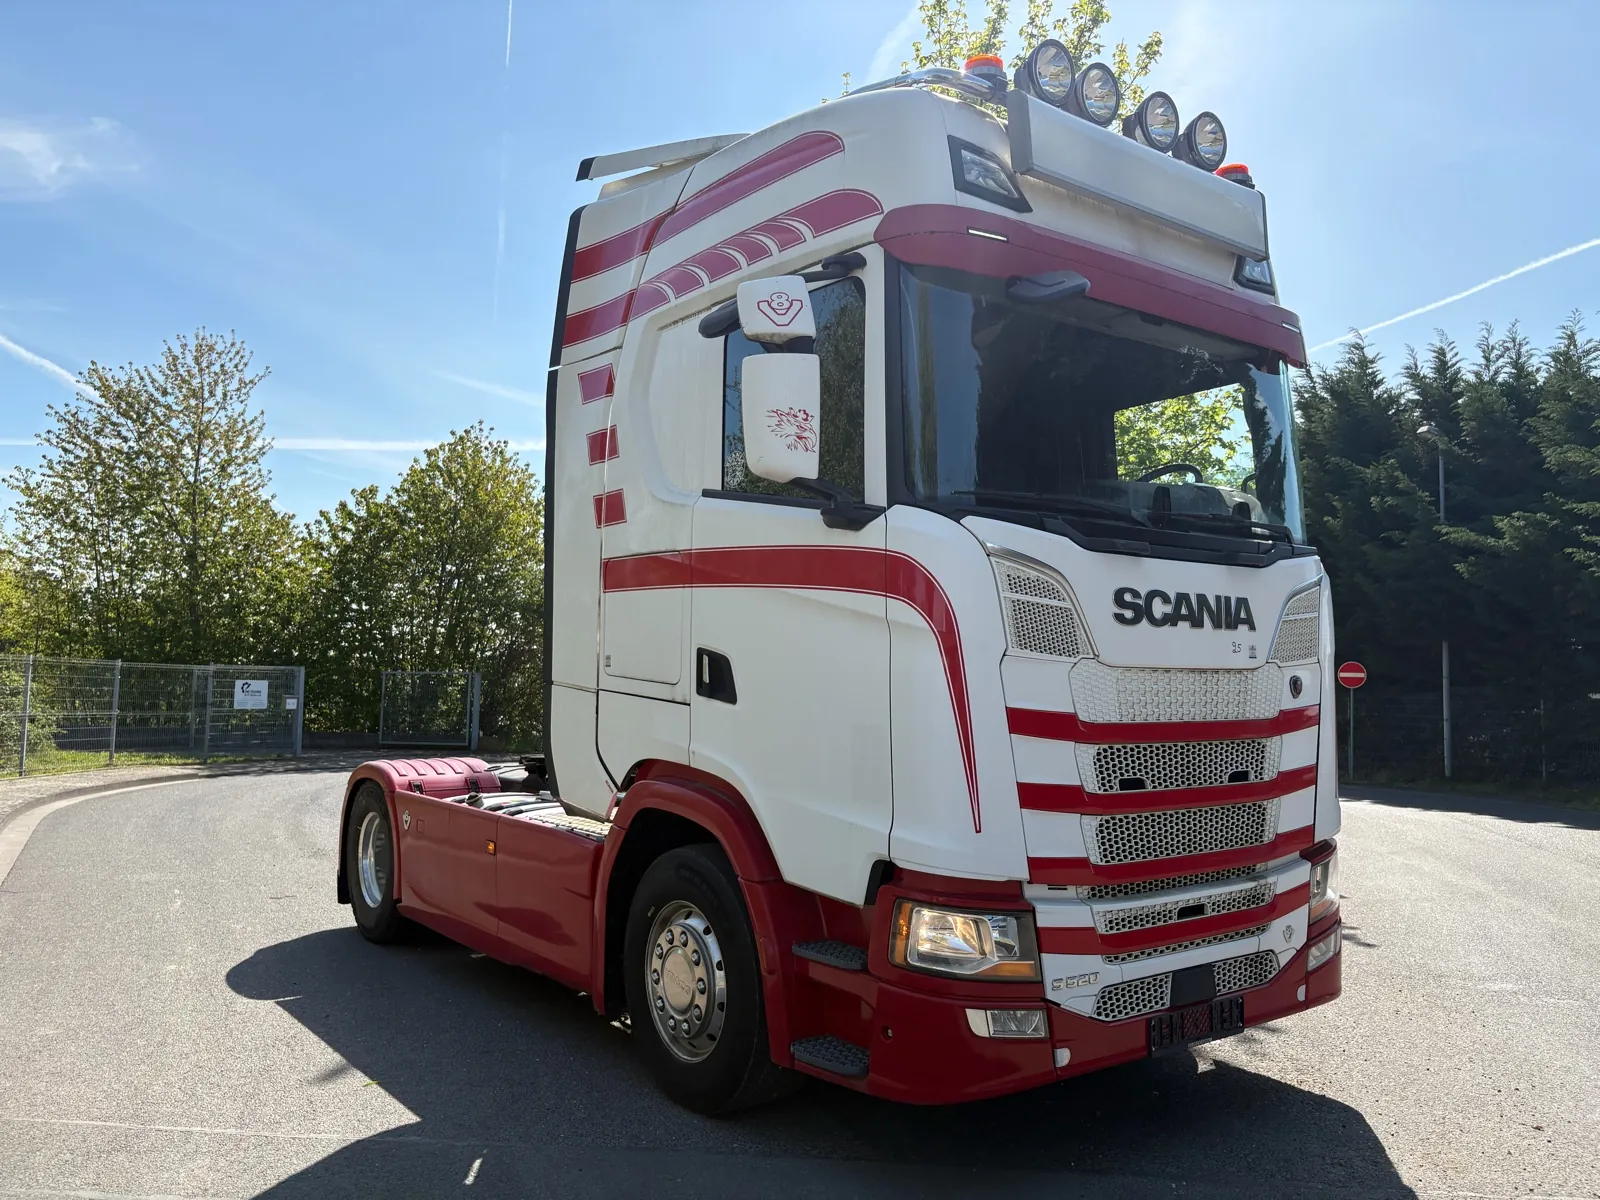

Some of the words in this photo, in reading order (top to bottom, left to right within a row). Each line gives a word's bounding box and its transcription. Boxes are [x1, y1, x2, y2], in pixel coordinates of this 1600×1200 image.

[1112, 586, 1257, 632] SCANIA
[1051, 977, 1064, 991] S
[1066, 971, 1100, 989] 520
